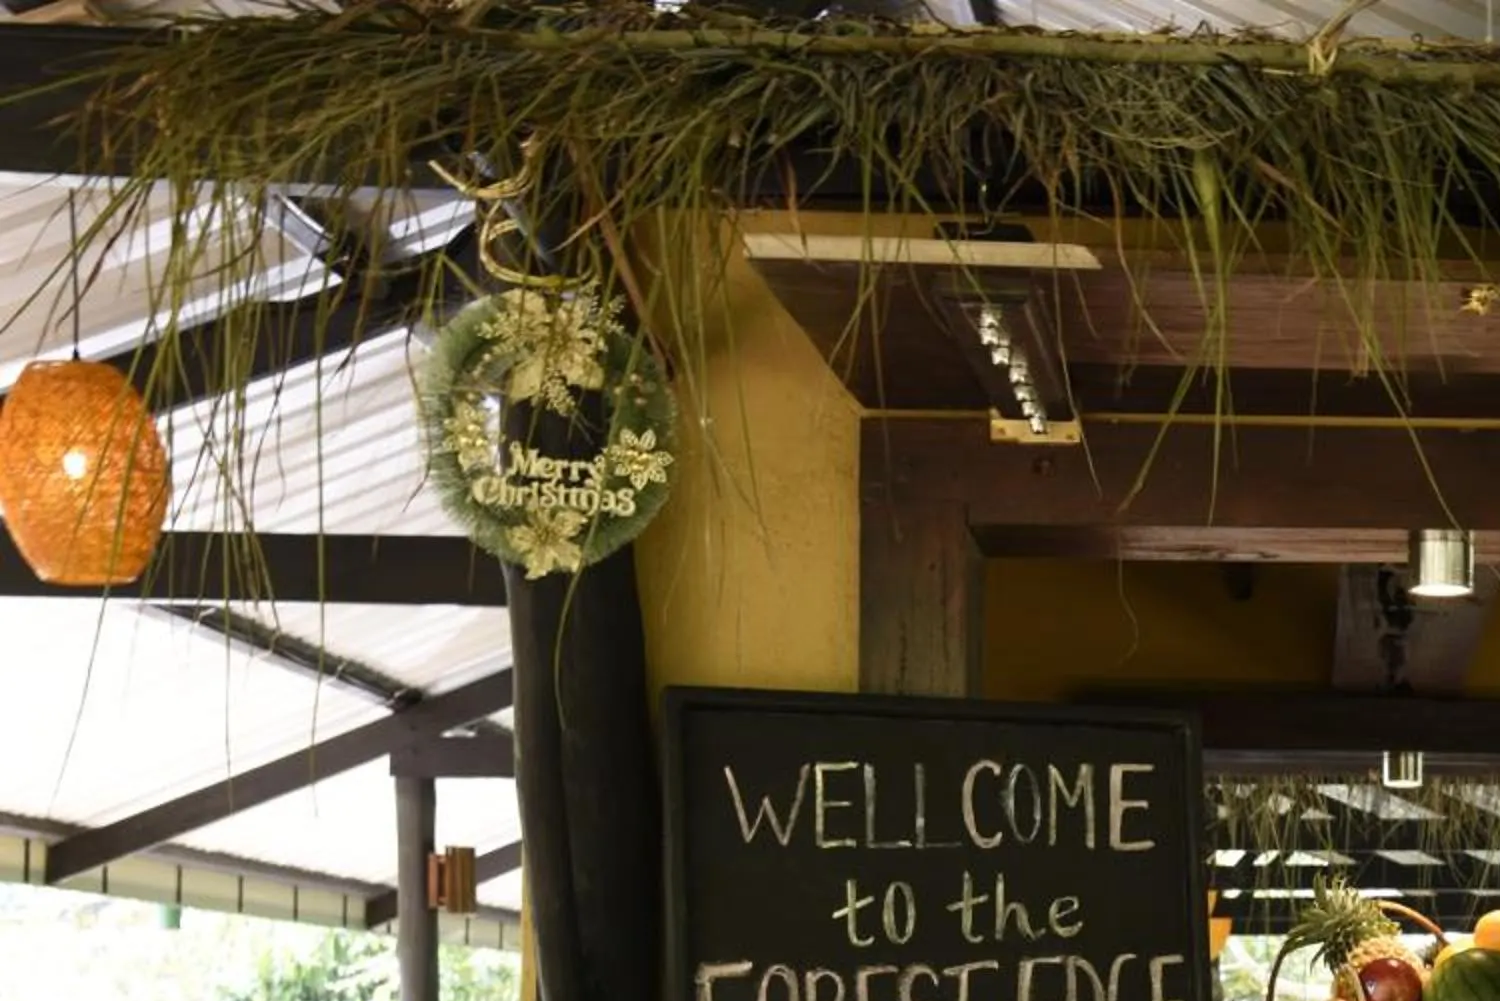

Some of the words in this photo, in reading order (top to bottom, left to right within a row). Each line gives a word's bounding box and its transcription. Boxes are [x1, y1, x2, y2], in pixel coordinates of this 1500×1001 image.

[507, 441, 607, 486] Merry
[471, 474, 637, 517] Christmas
[945, 870, 1084, 944] the
